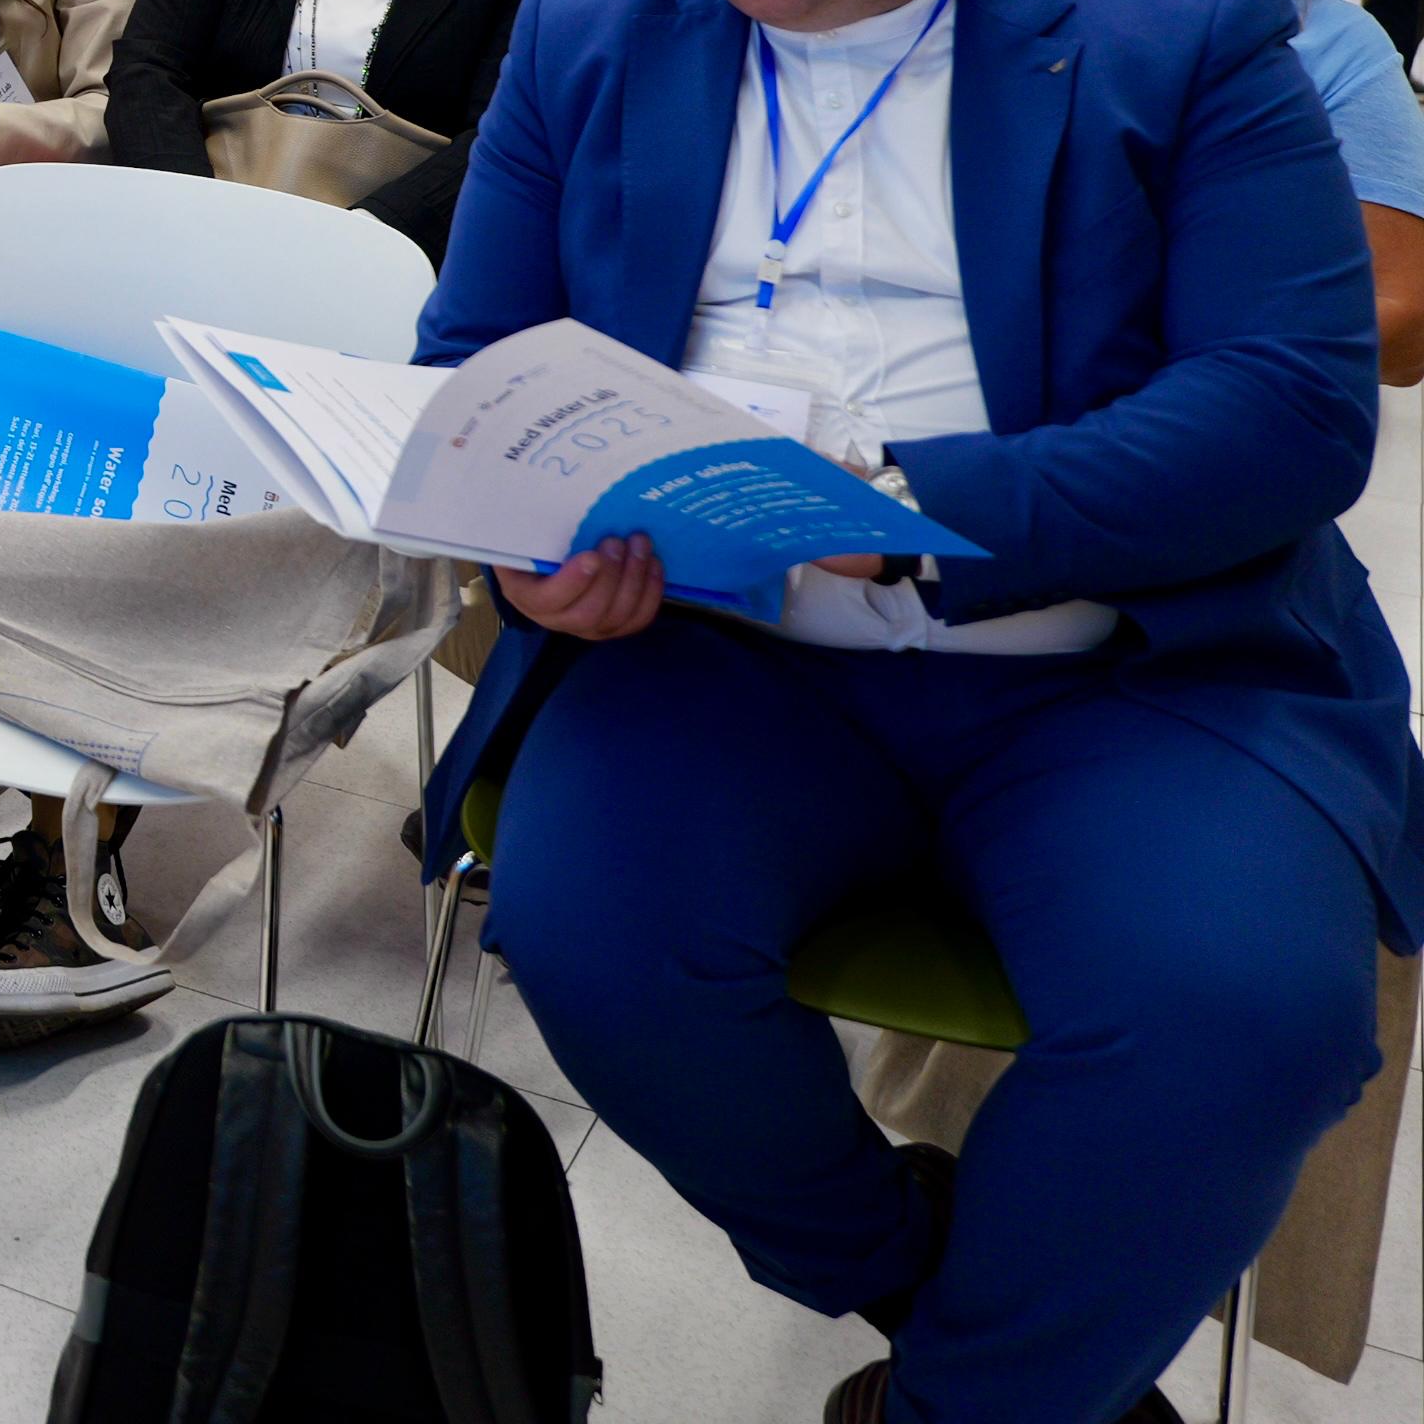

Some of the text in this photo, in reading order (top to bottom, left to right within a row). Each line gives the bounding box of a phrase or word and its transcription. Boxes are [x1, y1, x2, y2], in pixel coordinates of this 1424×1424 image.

[10, 415, 20, 432] Sala
[21, 419, 32, 438] Fiera
[504, 388, 619, 461] Med Water Lab
[542, 406, 673, 476] 2025
[17, 438, 26, 452] del
[48, 446, 60, 469] segno
[7, 451, 23, 480] Levante
[14, 461, 30, 497] settembre
[90, 447, 125, 518] Water so
[47, 468, 64, 504] workshop,
[163, 464, 201, 519] 20
[216, 480, 238, 517] Med
[639, 475, 694, 502] Water
